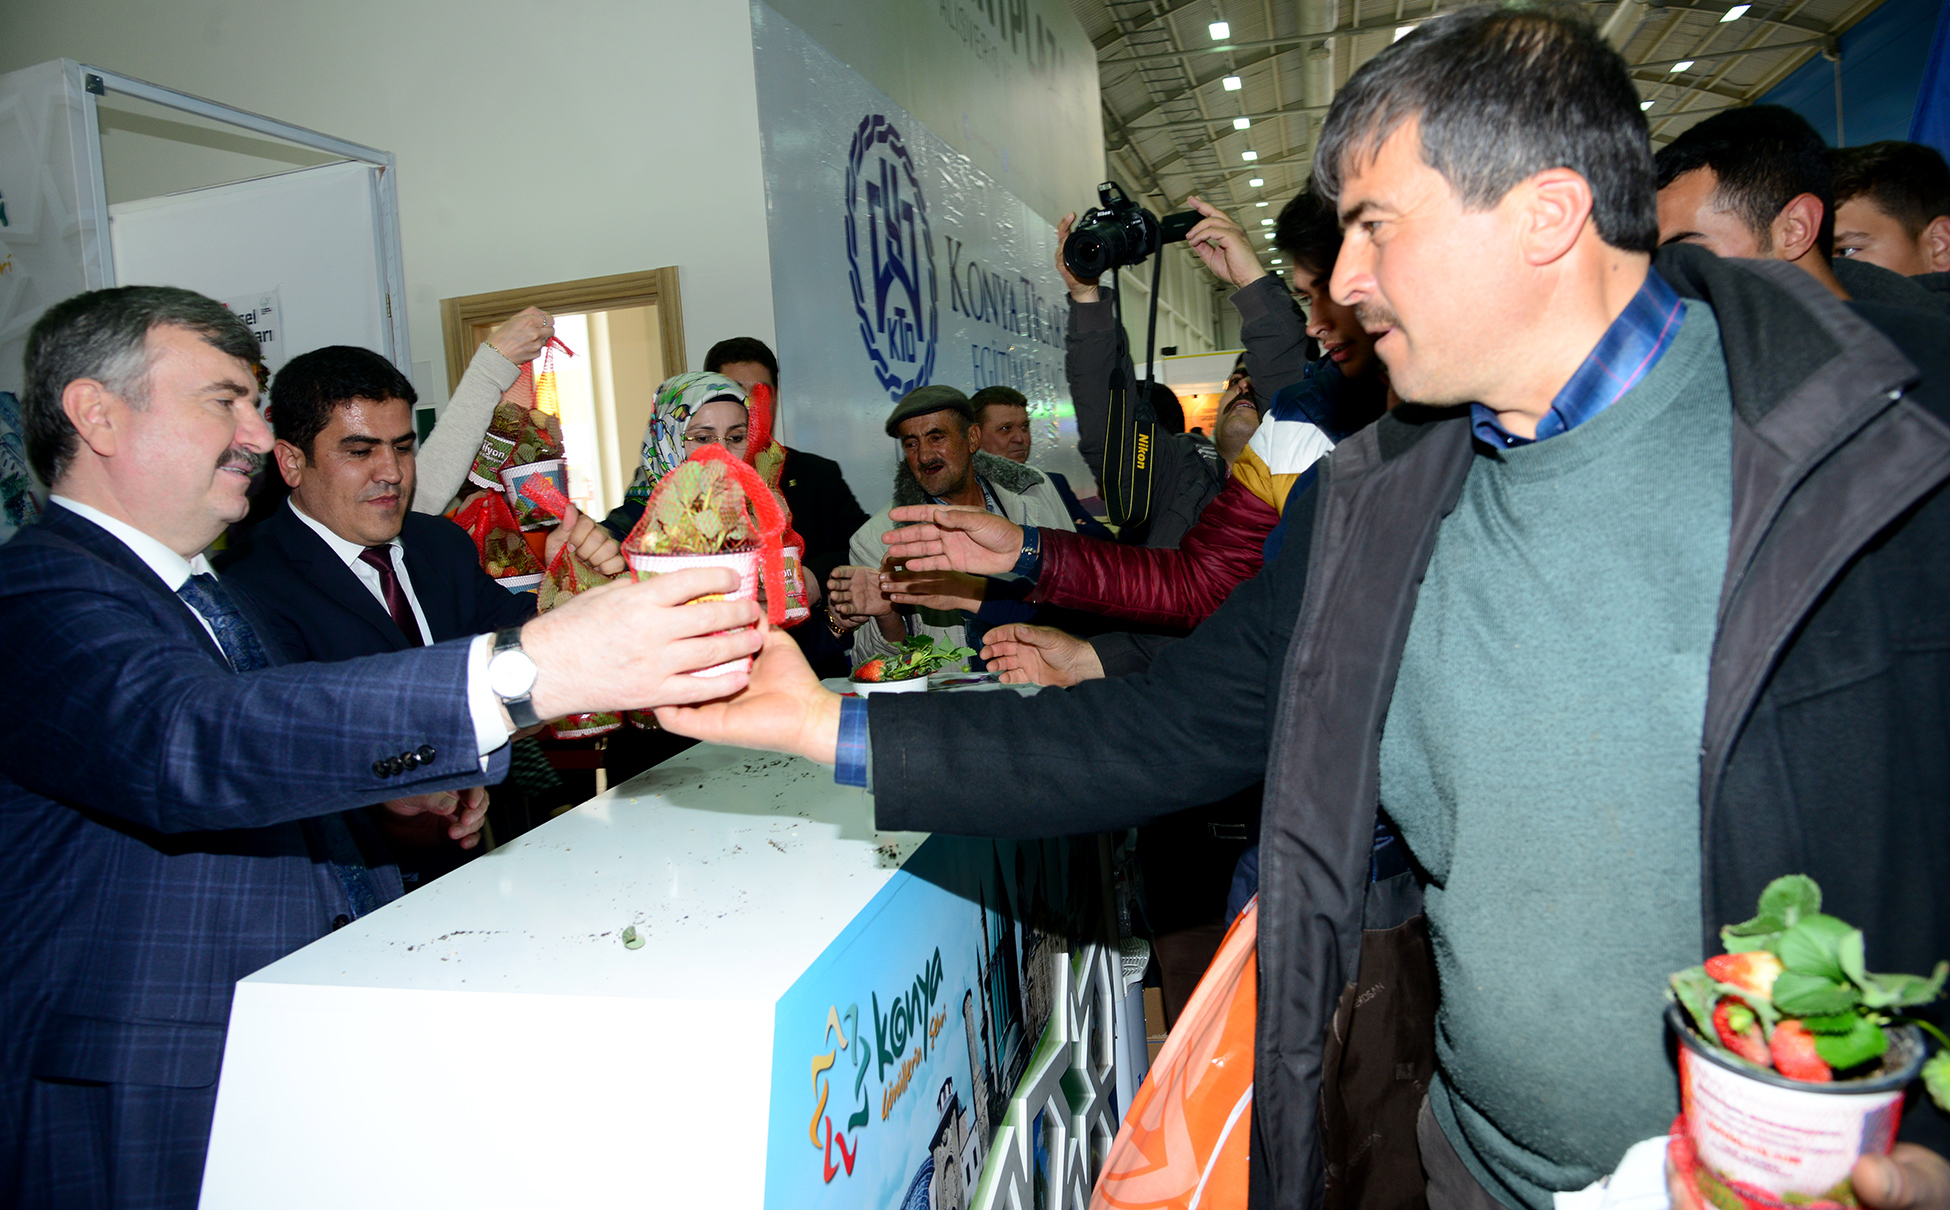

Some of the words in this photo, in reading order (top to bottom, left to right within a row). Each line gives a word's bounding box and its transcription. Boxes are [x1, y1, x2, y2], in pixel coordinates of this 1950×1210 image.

[887, 306, 916, 364] KTO
[945, 235, 1021, 335] KONYA
[1136, 433, 1150, 470] Nikon
[871, 945, 944, 1084] konya
[881, 1045, 923, 1122] Gönüllerin
[928, 1002, 948, 1051] Şehri
